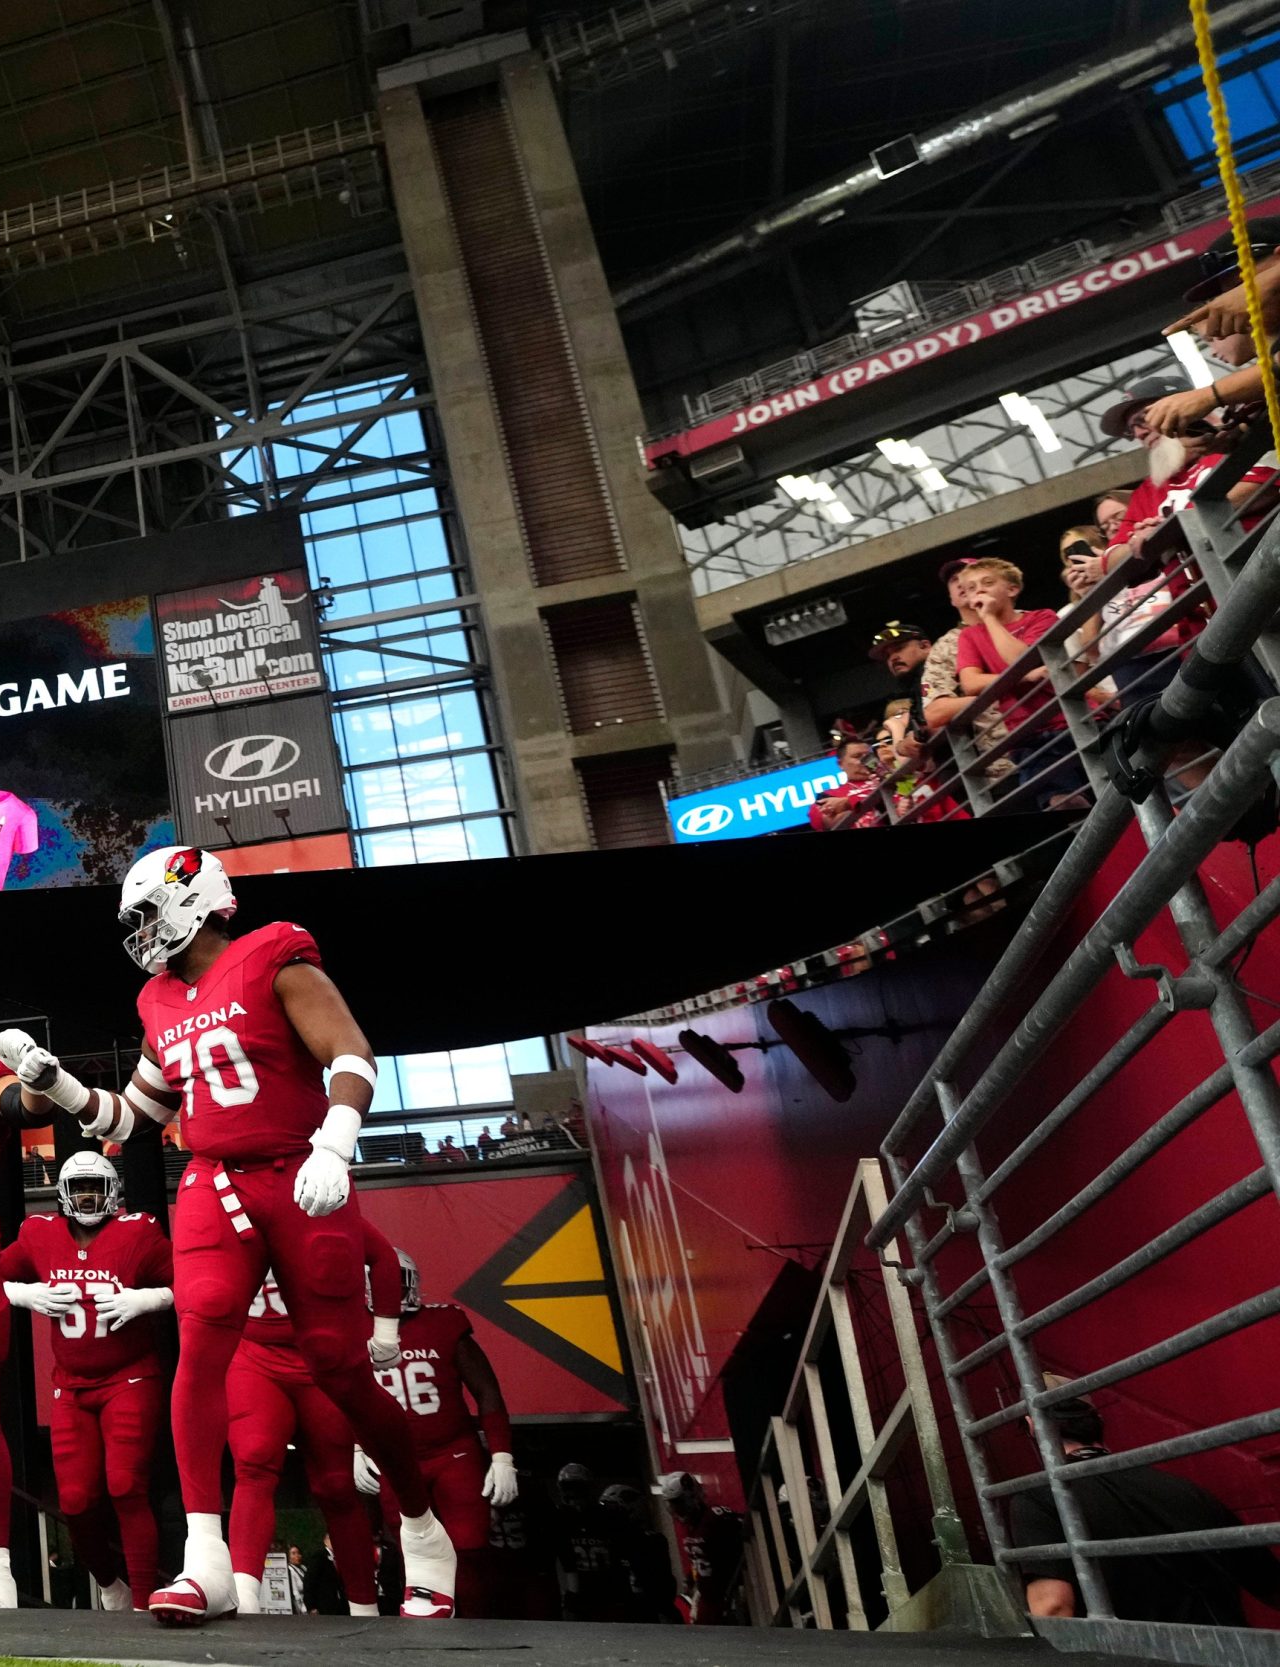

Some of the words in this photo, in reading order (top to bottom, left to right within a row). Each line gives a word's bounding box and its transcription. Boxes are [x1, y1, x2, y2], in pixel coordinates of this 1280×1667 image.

[729, 384, 821, 434] JOHN
[827, 320, 983, 396] (PADDY)
[990, 240, 1195, 333] DRISCOLL
[162, 618, 214, 642] Shop
[216, 603, 271, 633] Local
[165, 631, 246, 662] Support
[246, 619, 302, 649] Local
[167, 648, 315, 694] NoBullcom
[238, 684, 268, 697] AUTO
[194, 777, 321, 814] HYUNDAI
[157, 1001, 248, 1051] ARIZONA
[162, 1025, 260, 1119] 70
[487, 1140, 551, 1161] CARDINALS
[54, 1282, 116, 1339] 67
[373, 1361, 441, 1415] 96
